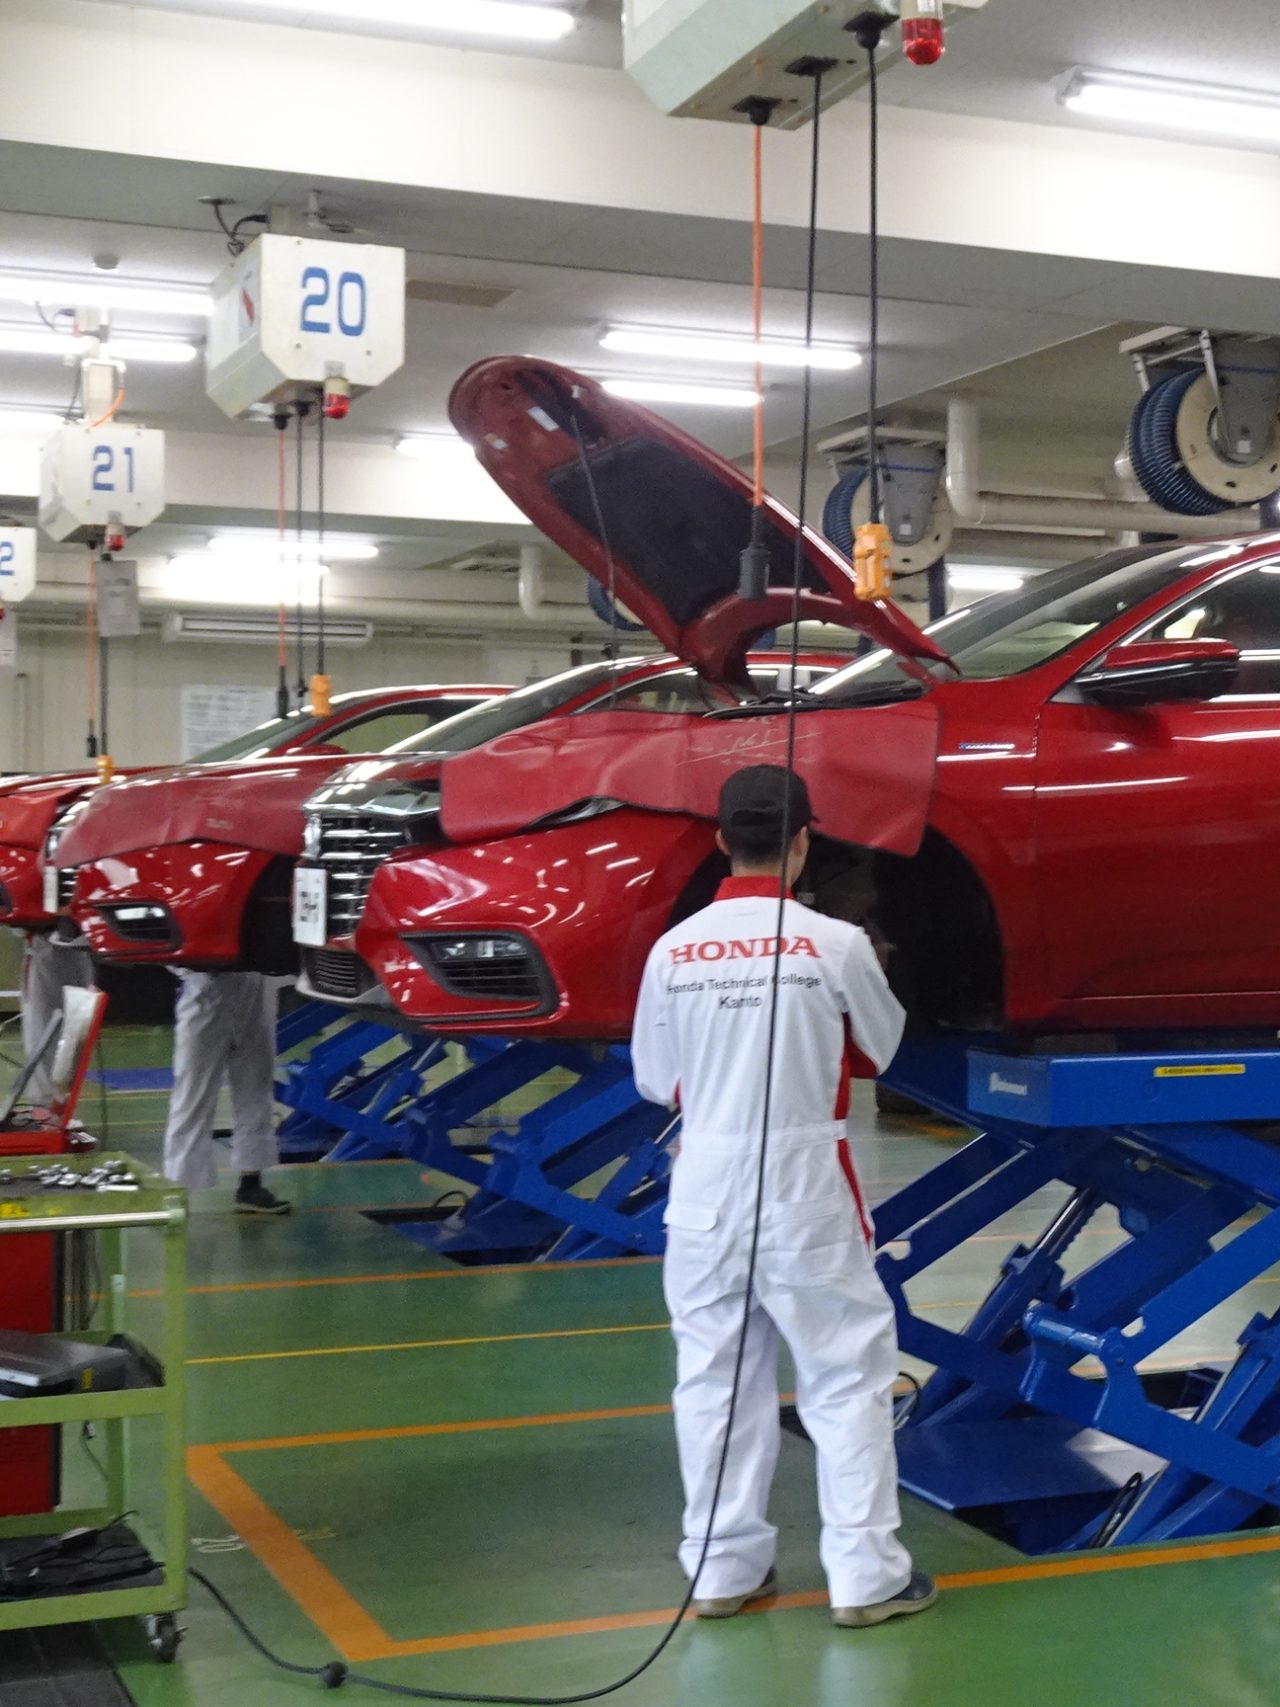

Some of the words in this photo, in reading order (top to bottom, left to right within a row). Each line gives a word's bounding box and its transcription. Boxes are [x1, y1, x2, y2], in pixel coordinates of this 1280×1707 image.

[300, 265, 367, 337] 20
[92, 445, 135, 493] 21
[668, 935, 822, 965] HONDA
[707, 975, 767, 990] Technical
